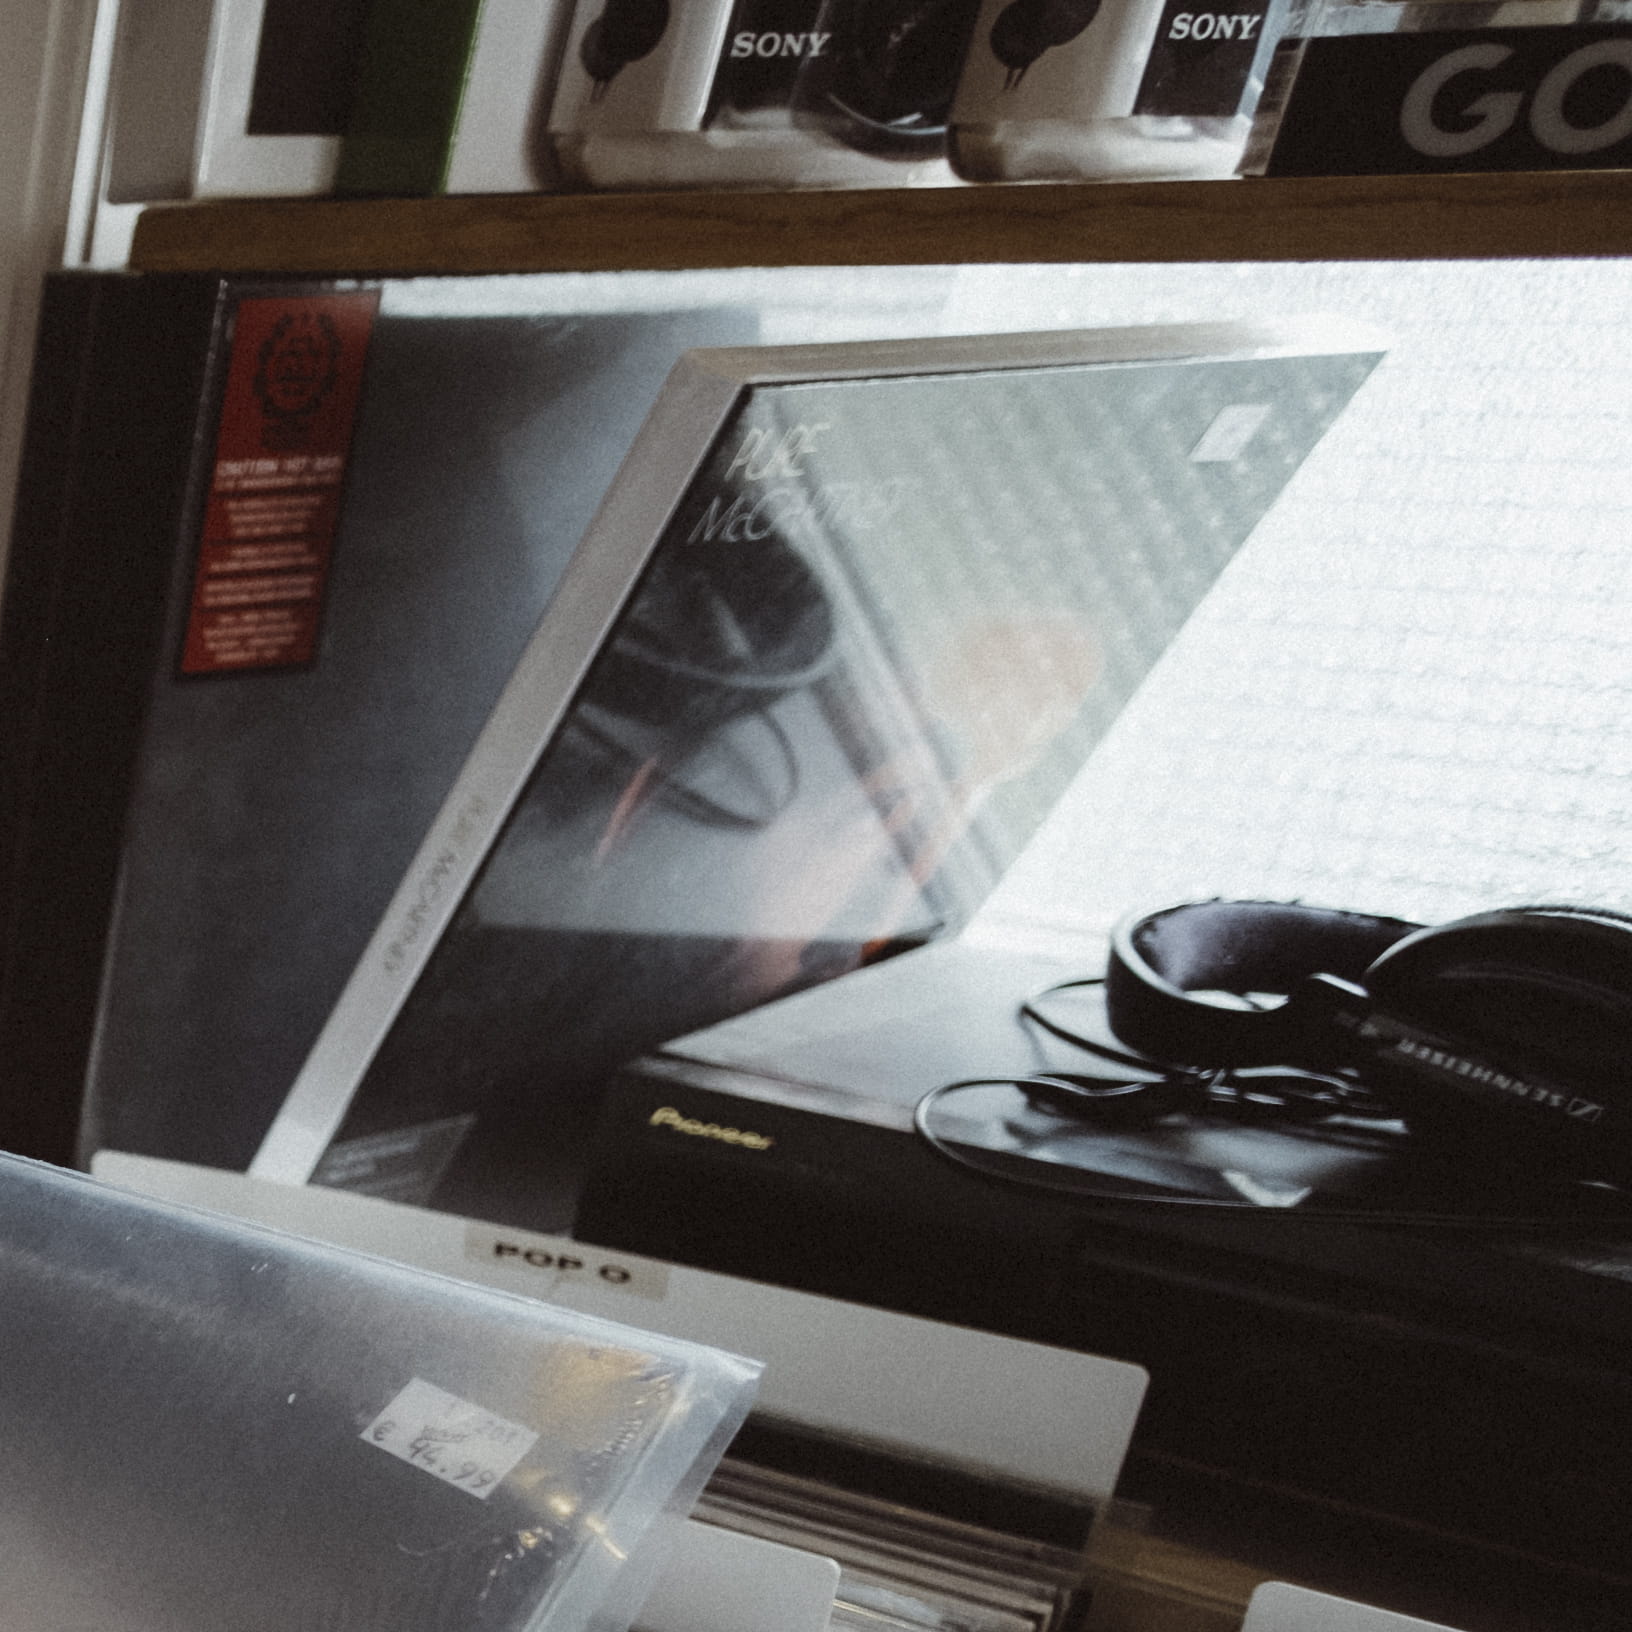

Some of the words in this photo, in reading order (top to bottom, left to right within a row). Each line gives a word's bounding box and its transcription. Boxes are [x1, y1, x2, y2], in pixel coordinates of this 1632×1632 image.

[1169, 12, 1261, 40] SONY
[731, 32, 832, 58] SONY
[495, 1243, 582, 1271] POP
